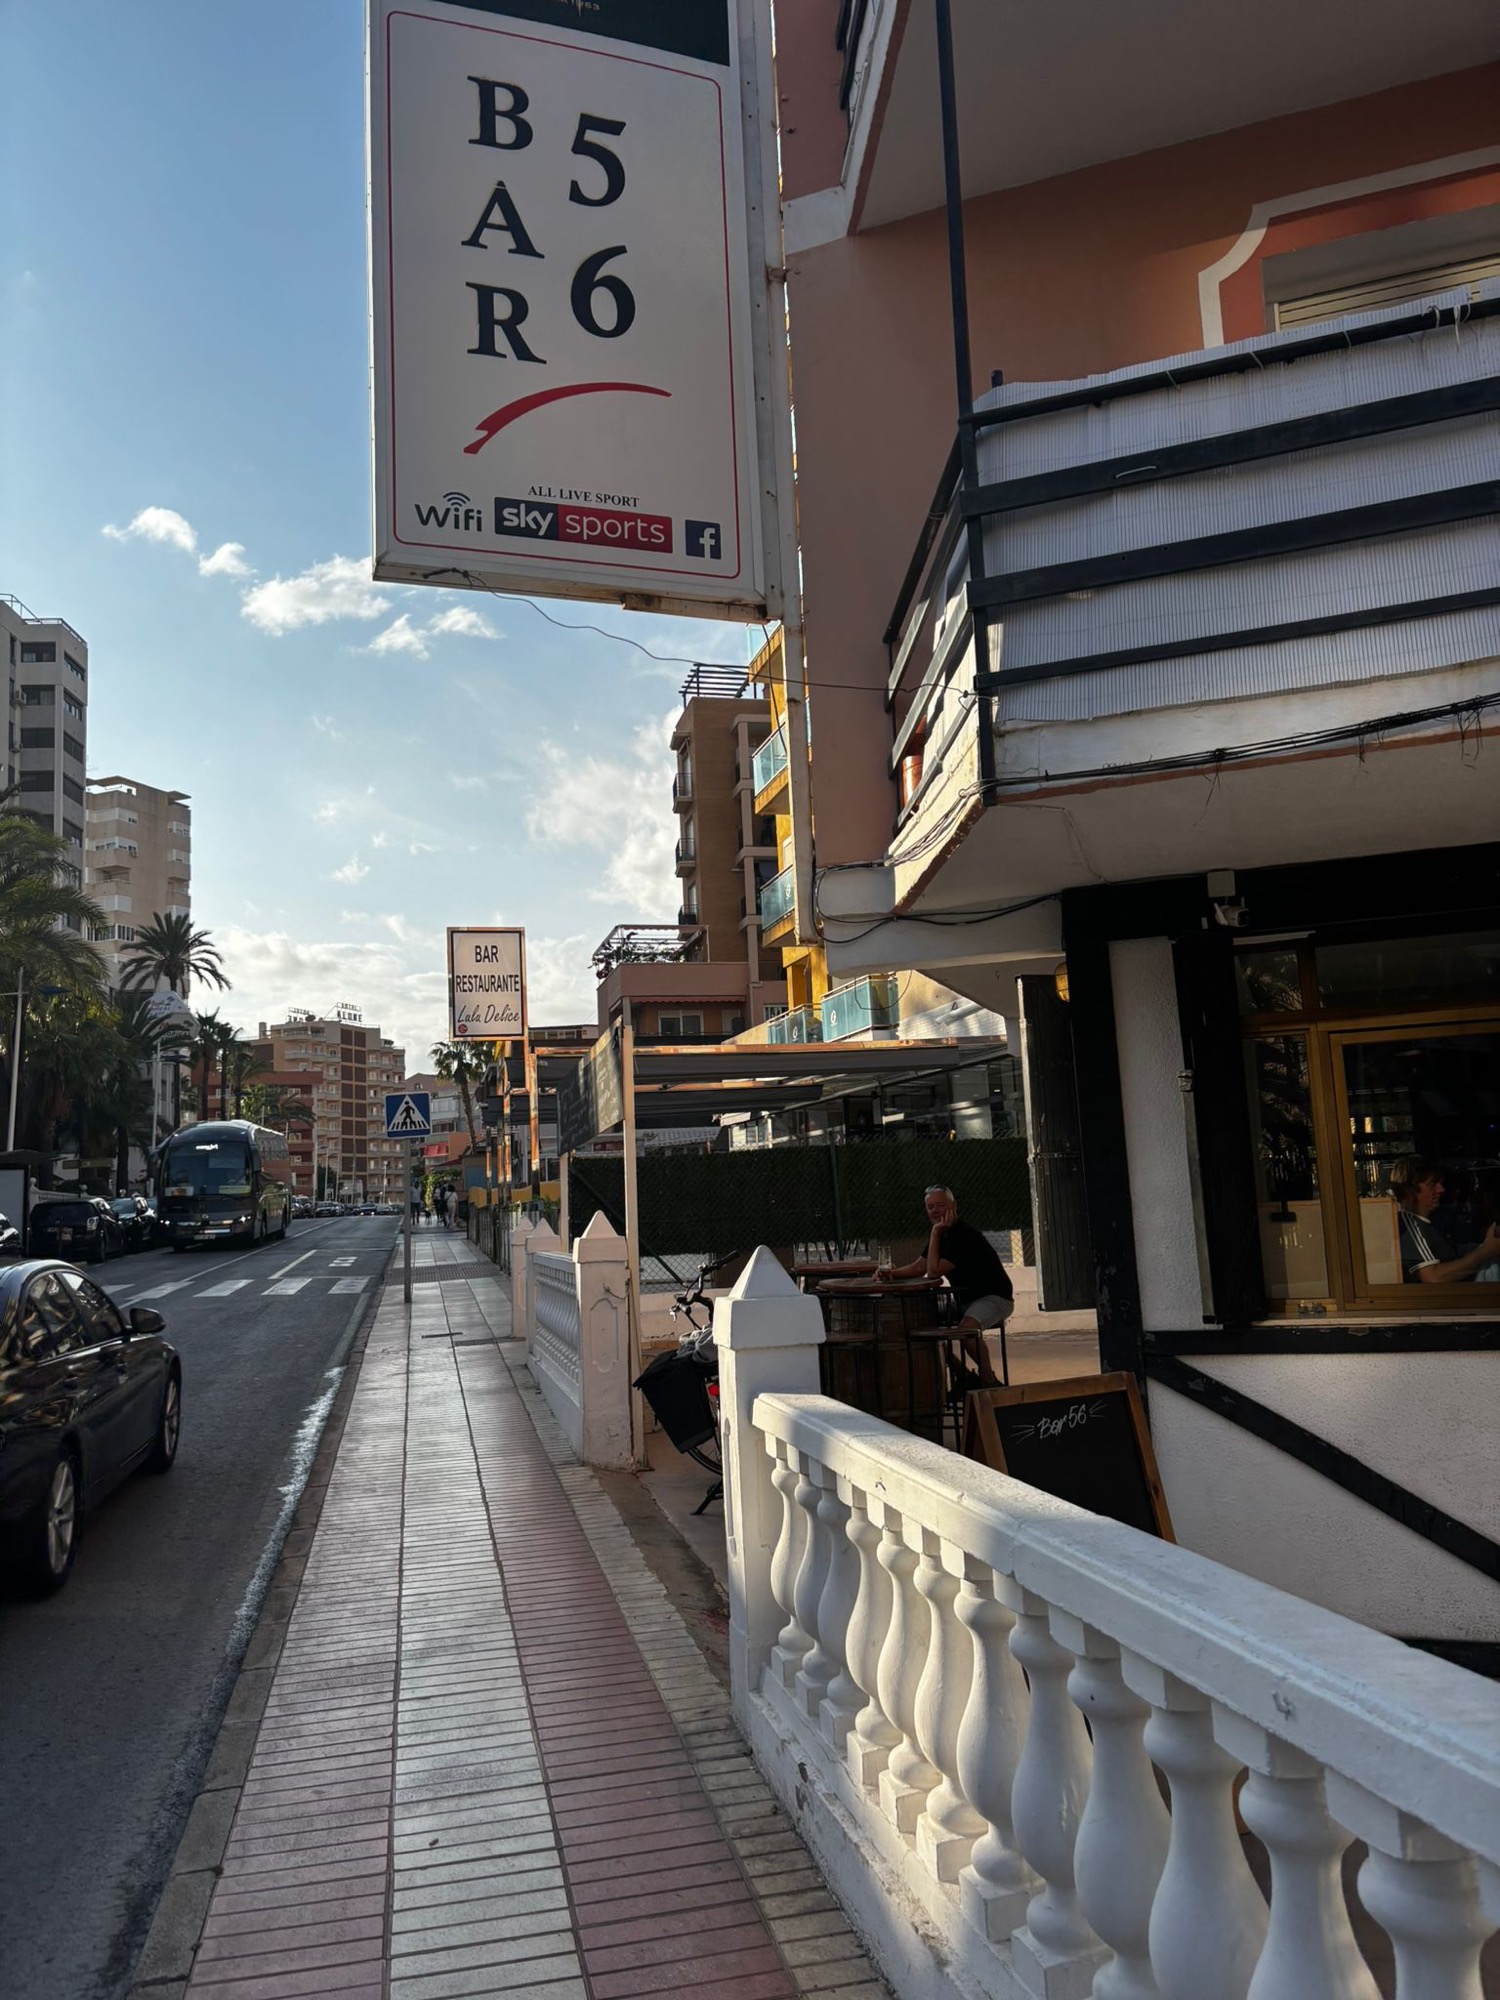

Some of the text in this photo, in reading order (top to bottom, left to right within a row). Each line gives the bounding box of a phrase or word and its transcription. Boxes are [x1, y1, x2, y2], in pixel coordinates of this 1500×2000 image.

[461, 75, 547, 364] BAR
[569, 113, 636, 339] 56
[527, 485, 640, 508] ALL LIVE SPORT
[502, 503, 665, 543] sky sports
[475, 945, 499, 963] BAR
[456, 974, 520, 993] RESTAURANTE
[457, 1003, 520, 1024] Lala Delice
[1037, 1403, 1087, 1440] Bar 56
